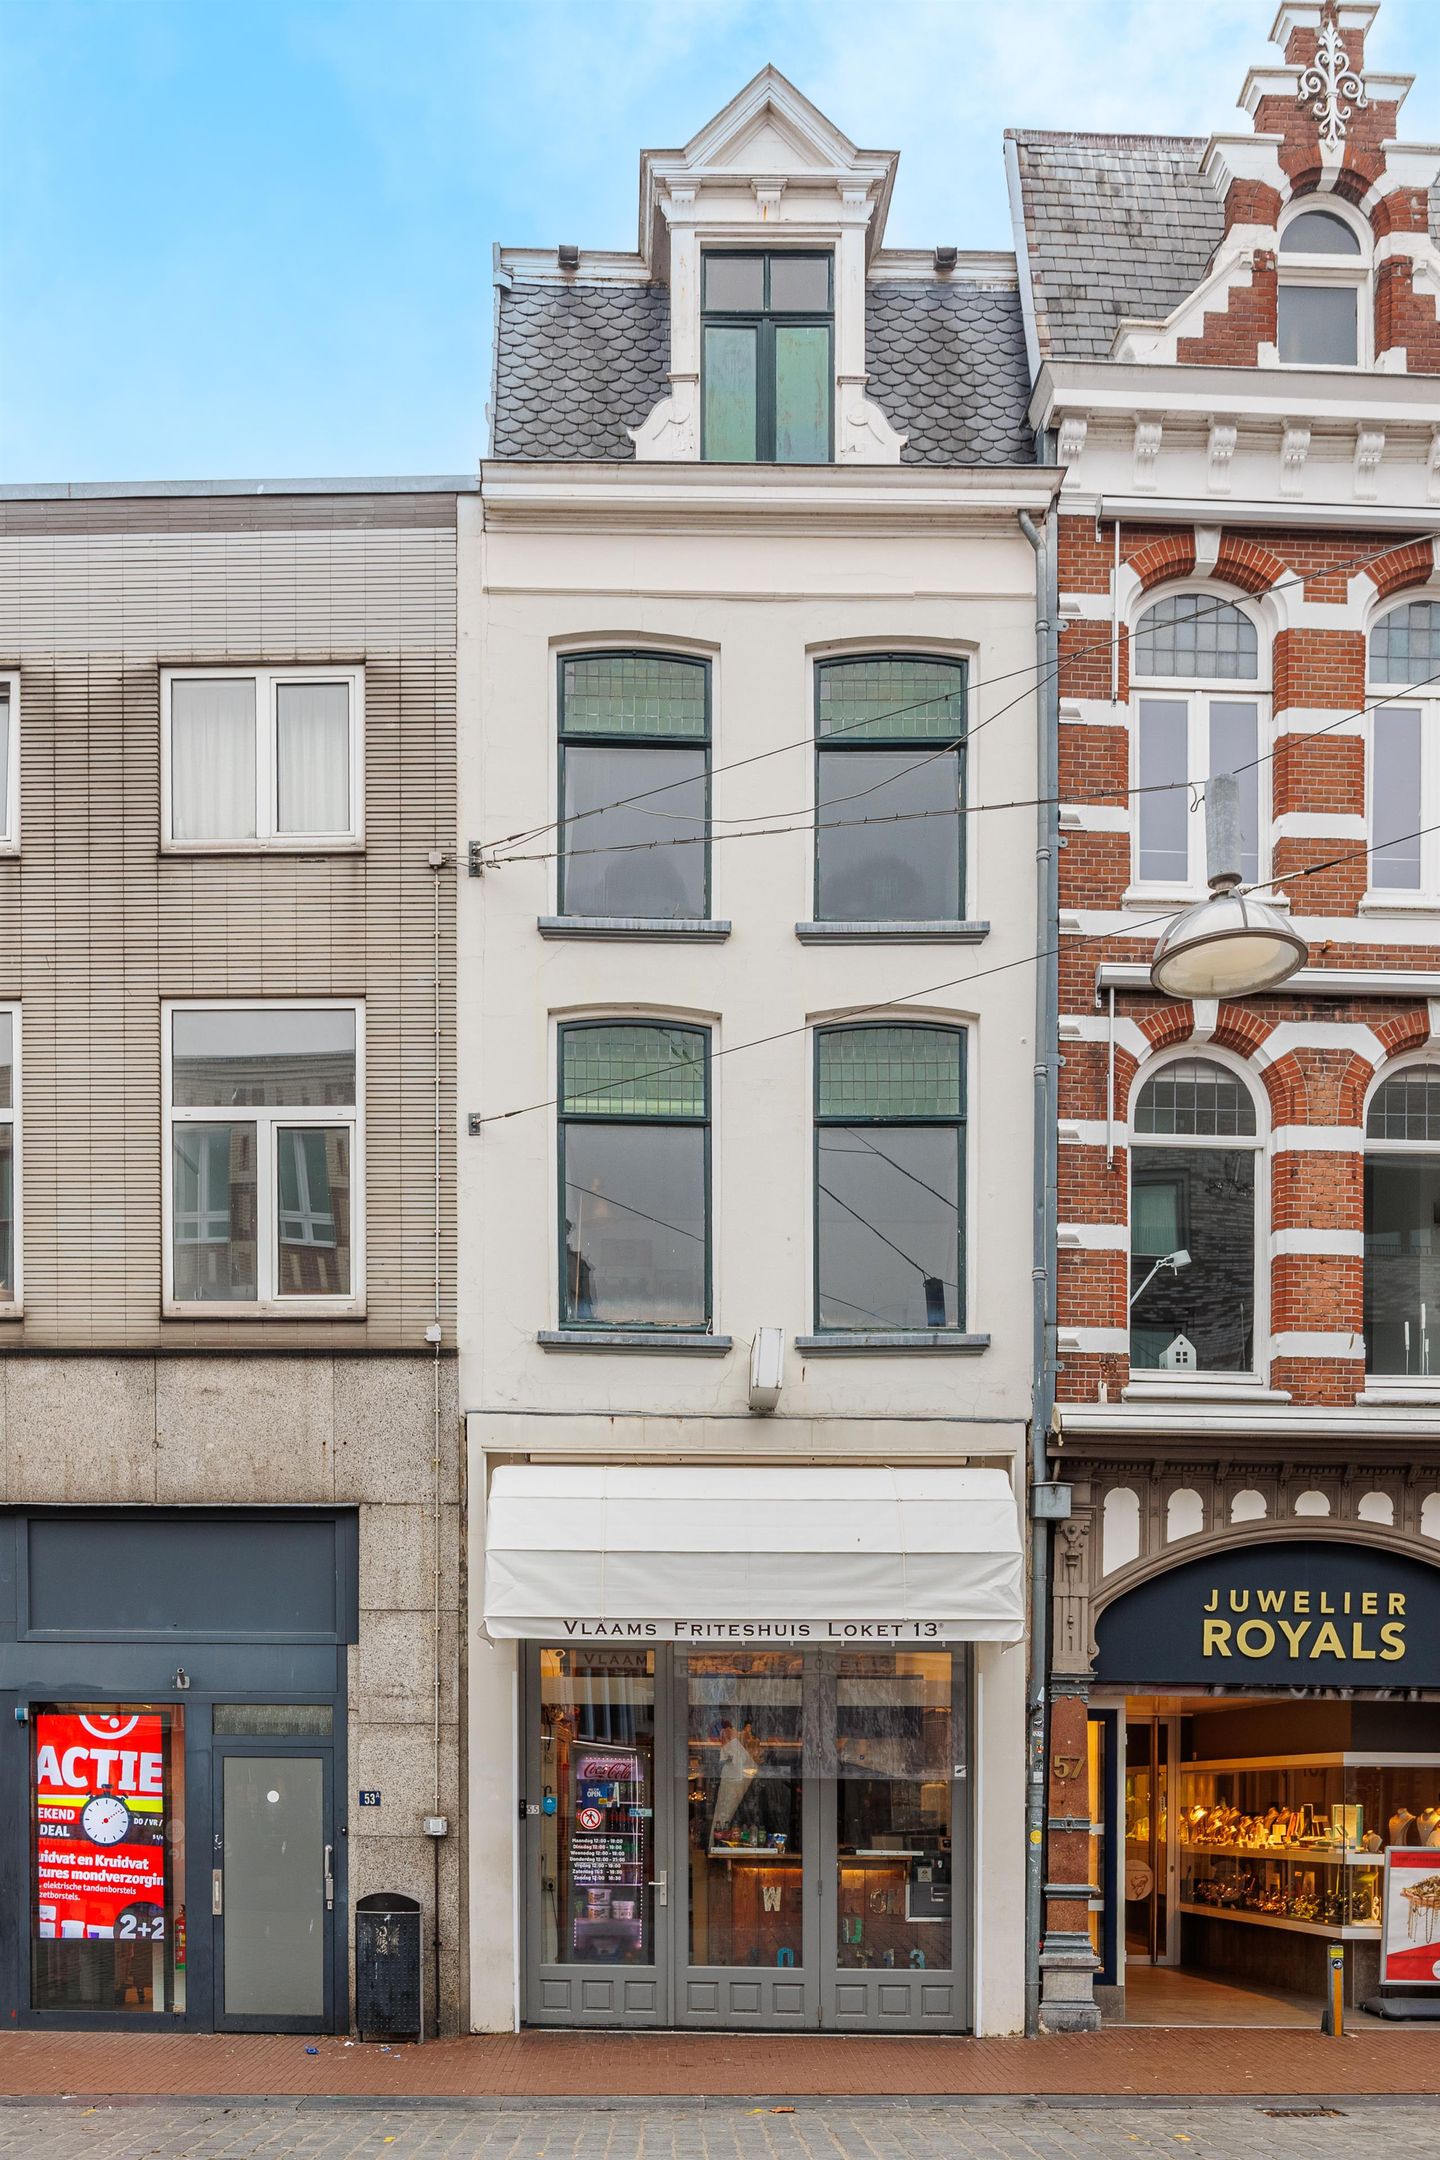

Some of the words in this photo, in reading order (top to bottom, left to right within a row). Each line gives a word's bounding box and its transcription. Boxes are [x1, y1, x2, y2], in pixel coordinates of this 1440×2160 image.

[1203, 1589, 1406, 1615] JUWELIER
[563, 1620, 657, 1636] VLAAMS
[674, 1621, 811, 1637] FRITESHUIS
[828, 1622, 903, 1637] LOKET
[1202, 1619, 1406, 1661] ROYALS
[38, 1745, 163, 1793] ACTIE
[1053, 1755, 1086, 1779] 57
[38, 1808, 75, 1820] EKEND
[133, 1817, 144, 1825] DO
[149, 1819, 158, 1827] VR
[40, 1824, 70, 1837] DEAL
[77, 1855, 93, 1866] en
[95, 1853, 149, 1870] Kruidvat
[71, 1869, 163, 1888] mondverzorgin
[43, 1881, 82, 1891] elektrische
[83, 1884, 136, 1895] tandenborstels
[119, 1913, 164, 1939] 2+2
